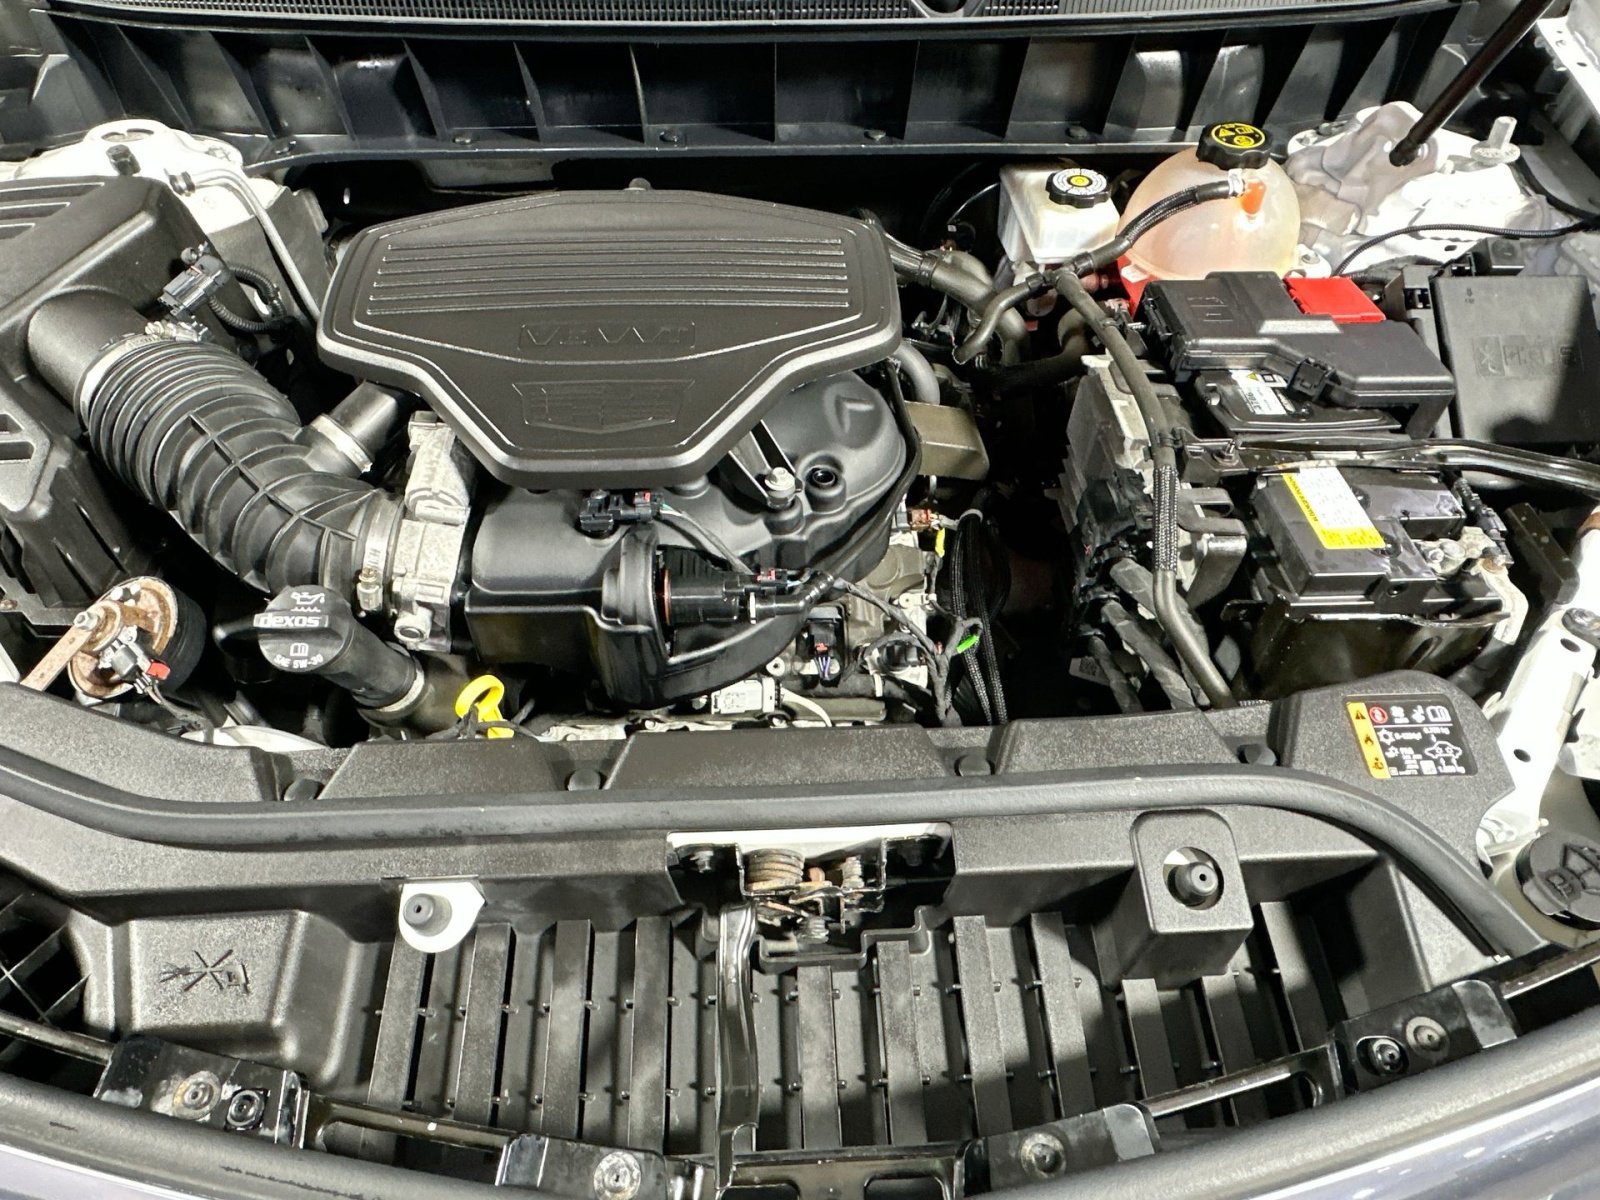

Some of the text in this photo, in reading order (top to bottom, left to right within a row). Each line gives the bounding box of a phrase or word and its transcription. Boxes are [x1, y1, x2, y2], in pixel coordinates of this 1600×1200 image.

[260, 613, 321, 627] dexos
[273, 653, 324, 669] SAE 5W-30
